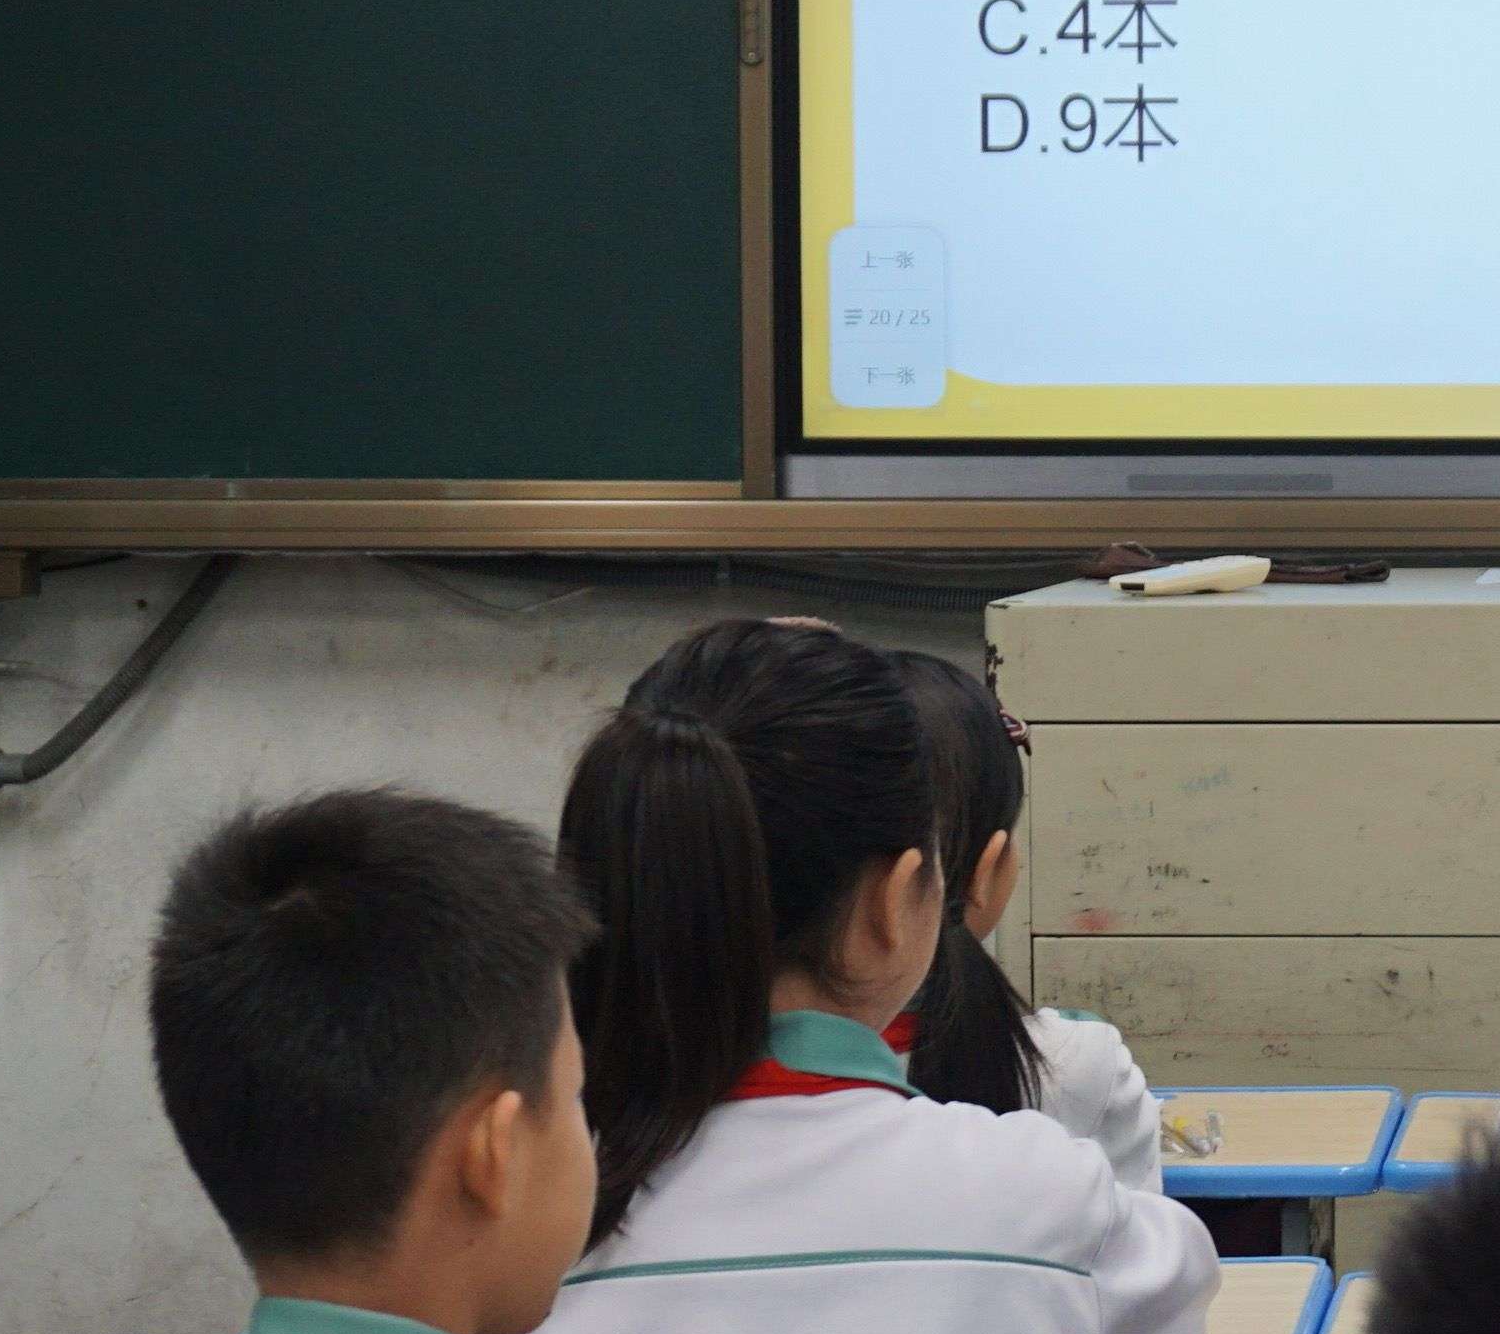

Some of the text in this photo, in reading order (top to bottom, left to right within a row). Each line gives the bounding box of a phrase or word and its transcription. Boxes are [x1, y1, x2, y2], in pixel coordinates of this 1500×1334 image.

[978, 83, 1181, 163] D.9本
[862, 251, 914, 269] 上一张
[862, 366, 915, 385] 下一张
